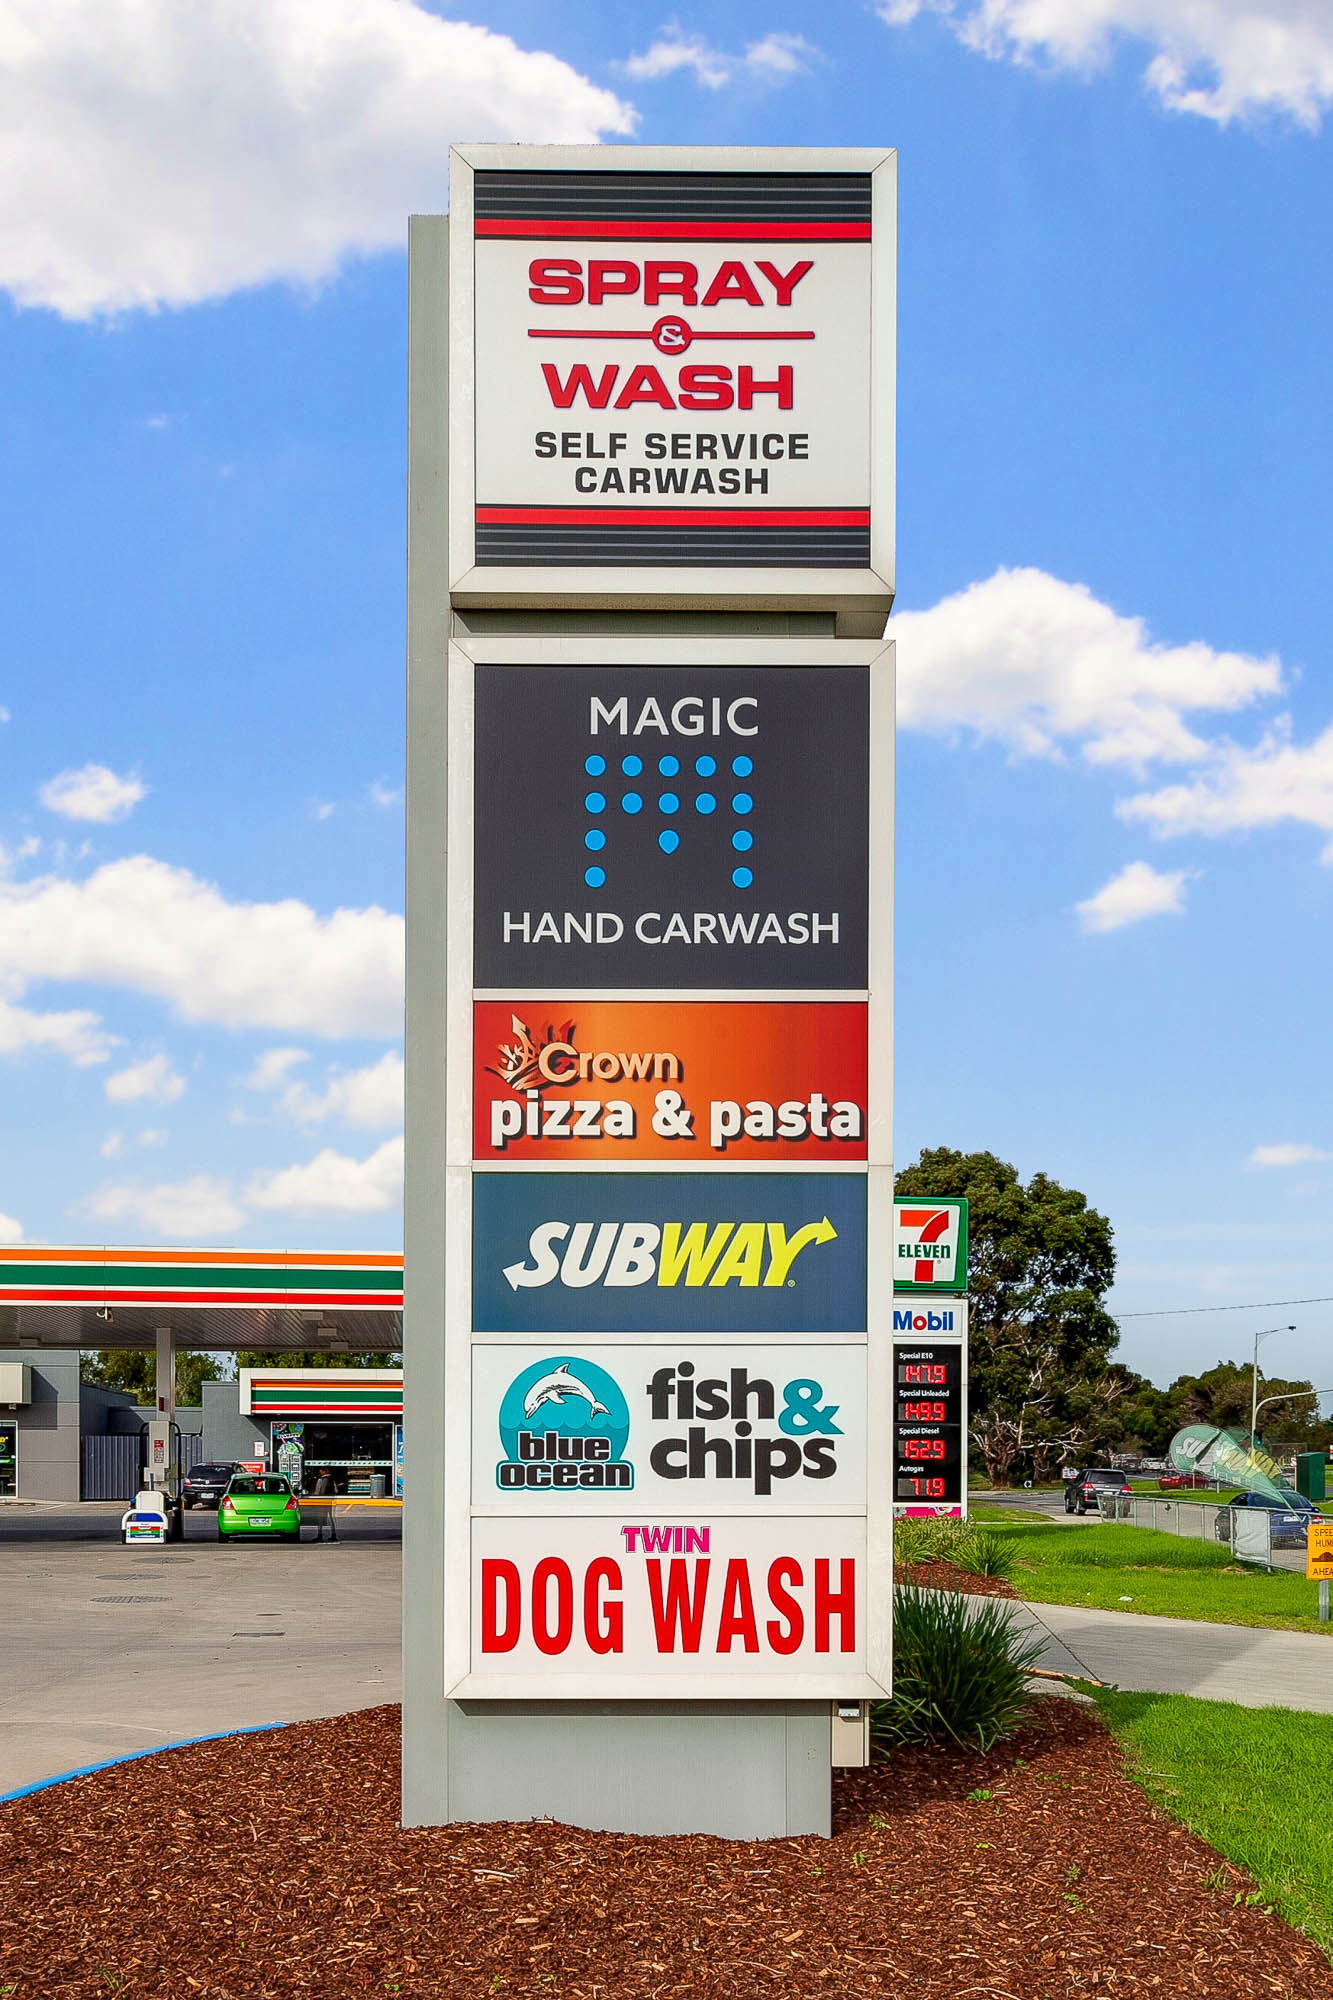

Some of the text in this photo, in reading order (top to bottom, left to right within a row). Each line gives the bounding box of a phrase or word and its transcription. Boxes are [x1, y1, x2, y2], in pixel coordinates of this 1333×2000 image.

[528, 259, 815, 306] SPRAY
[656, 324, 686, 346] &
[541, 363, 794, 411] WASH
[534, 432, 809, 460] SELF SERVICE
[575, 467, 769, 494] CARWASH
[589, 696, 759, 736] MAGIC
[502, 912, 840, 944] HAND CARWASH
[538, 1041, 679, 1083] Crown
[490, 1089, 861, 1147] pizza & pasta
[502, 1215, 838, 1292] SUBWAY
[900, 1210, 949, 1282] 7
[893, 1311, 954, 1331] Mobil
[899, 1353, 921, 1361] Special
[905, 1364, 946, 1384] 147.9
[647, 1361, 845, 1435] fish &
[899, 1390, 950, 1399] Special Unleaded
[905, 1402, 945, 1422] 149.9
[899, 1428, 921, 1436] Special
[518, 1432, 610, 1461] blue
[650, 1421, 838, 1496] chips
[904, 1440, 945, 1460] 152.9
[499, 1463, 632, 1488] ocean
[899, 1465, 924, 1474] Autogas
[909, 1478, 945, 1497] 71.9
[621, 1525, 711, 1554] TWIN
[481, 1557, 856, 1655] DOG WASH
